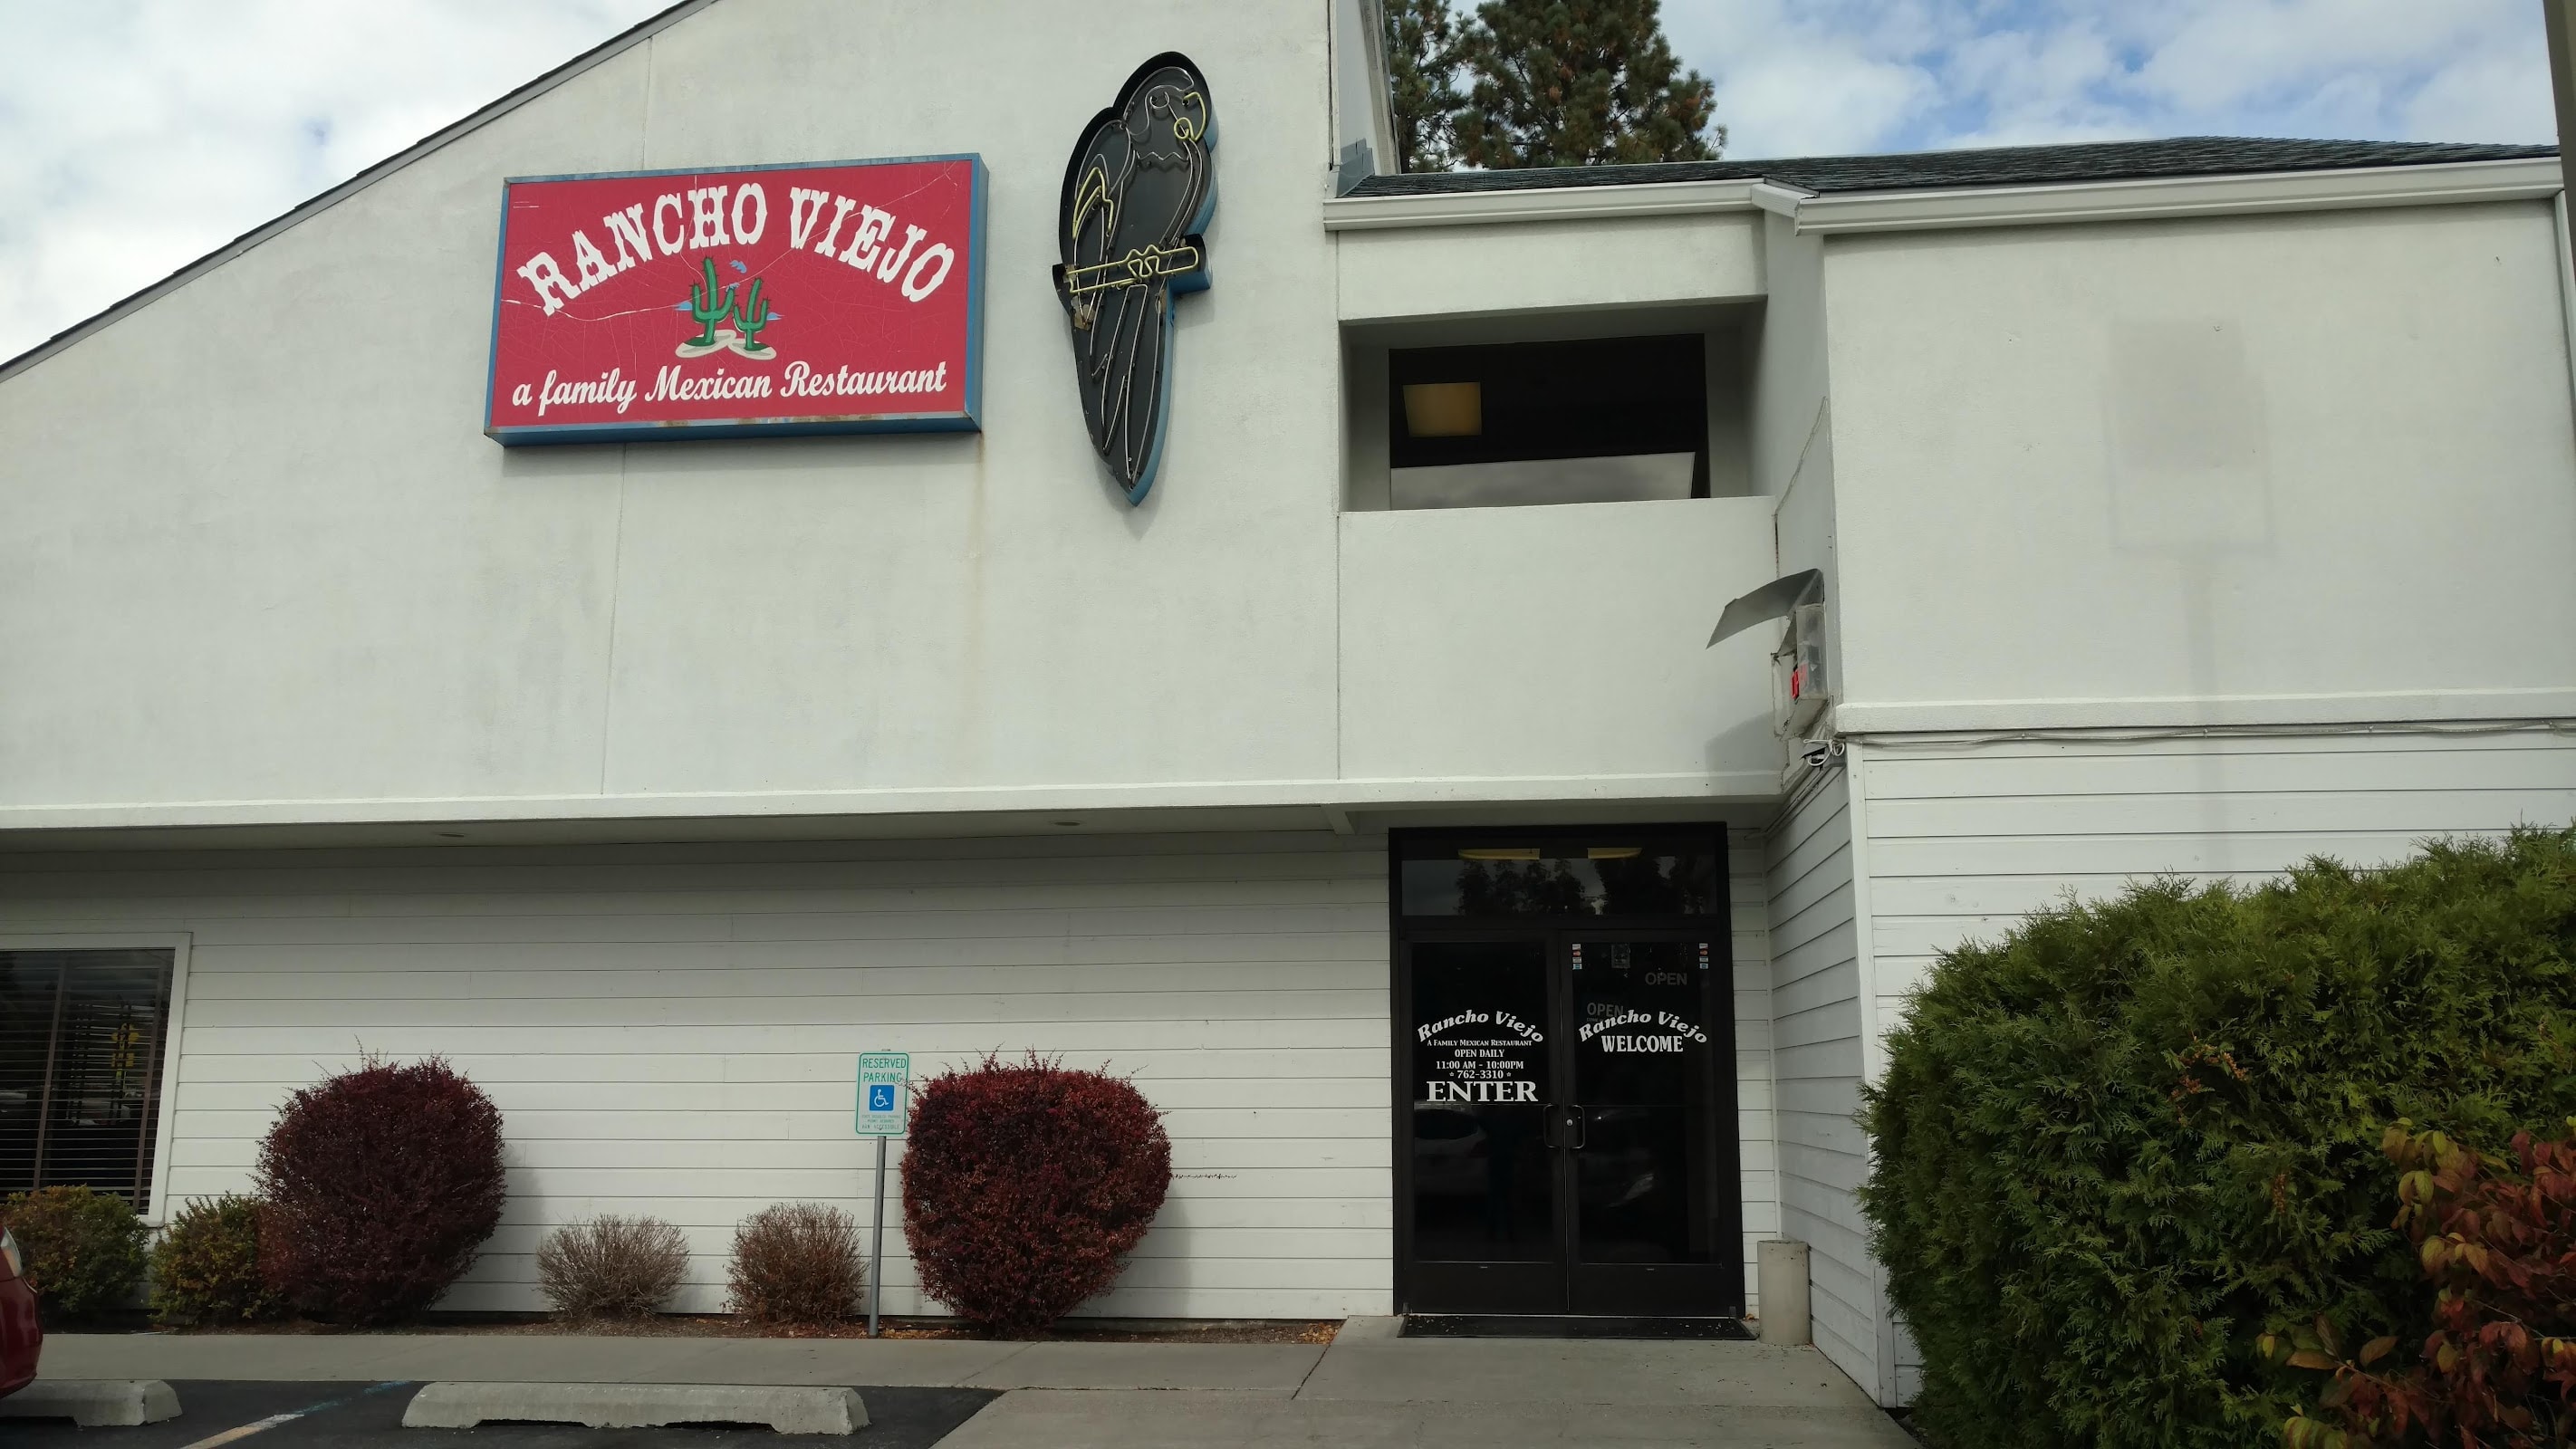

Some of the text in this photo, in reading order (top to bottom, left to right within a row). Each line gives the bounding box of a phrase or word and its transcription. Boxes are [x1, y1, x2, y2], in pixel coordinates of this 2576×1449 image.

[516, 182, 956, 316] RANCHO VIEJO
[513, 360, 947, 417] a family Mexican Restaurant
[1645, 972, 1687, 985] OPEN
[1587, 1002, 1624, 1017] OPEN
[1418, 1009, 1543, 1042] Rancho Viejo
[1579, 1009, 1707, 1043] Rancho Viejo
[1601, 1035, 1684, 1052] WELCOME
[1455, 1049, 1504, 1058] OPEN DAILY
[862, 1058, 907, 1069] RESERVED
[1436, 1060, 1460, 1070] 11:00
[1462, 1060, 1476, 1070] AM
[1486, 1060, 1524, 1070] 10:00PM
[863, 1072, 902, 1082] PARKING
[1456, 1070, 1504, 1079] 762-3310
[1426, 1080, 1539, 1102] ENTER
